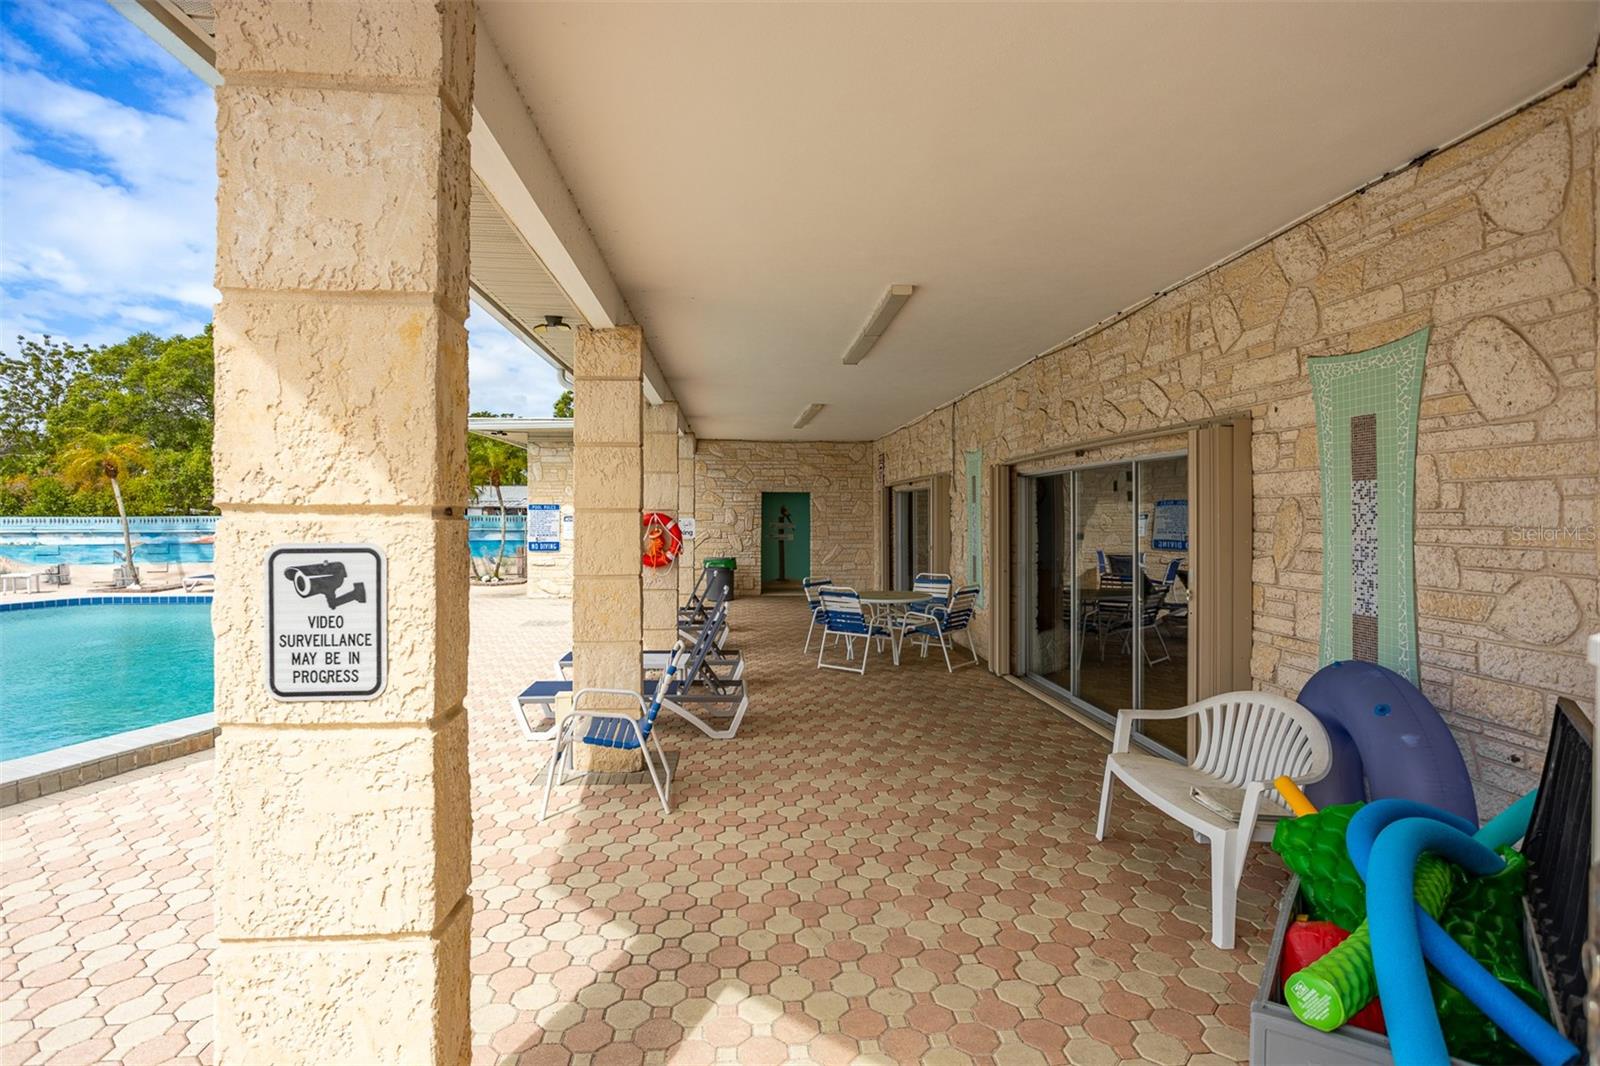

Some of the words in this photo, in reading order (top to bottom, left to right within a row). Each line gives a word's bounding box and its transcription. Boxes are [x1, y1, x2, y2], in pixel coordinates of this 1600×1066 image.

[308, 615, 344, 629] VIDEO
[279, 633, 372, 647] SURVEILLANCE
[291, 652, 317, 665] MAY
[325, 652, 341, 665] BE
[349, 651, 360, 665] IN
[293, 669, 359, 683] PROGRESS
